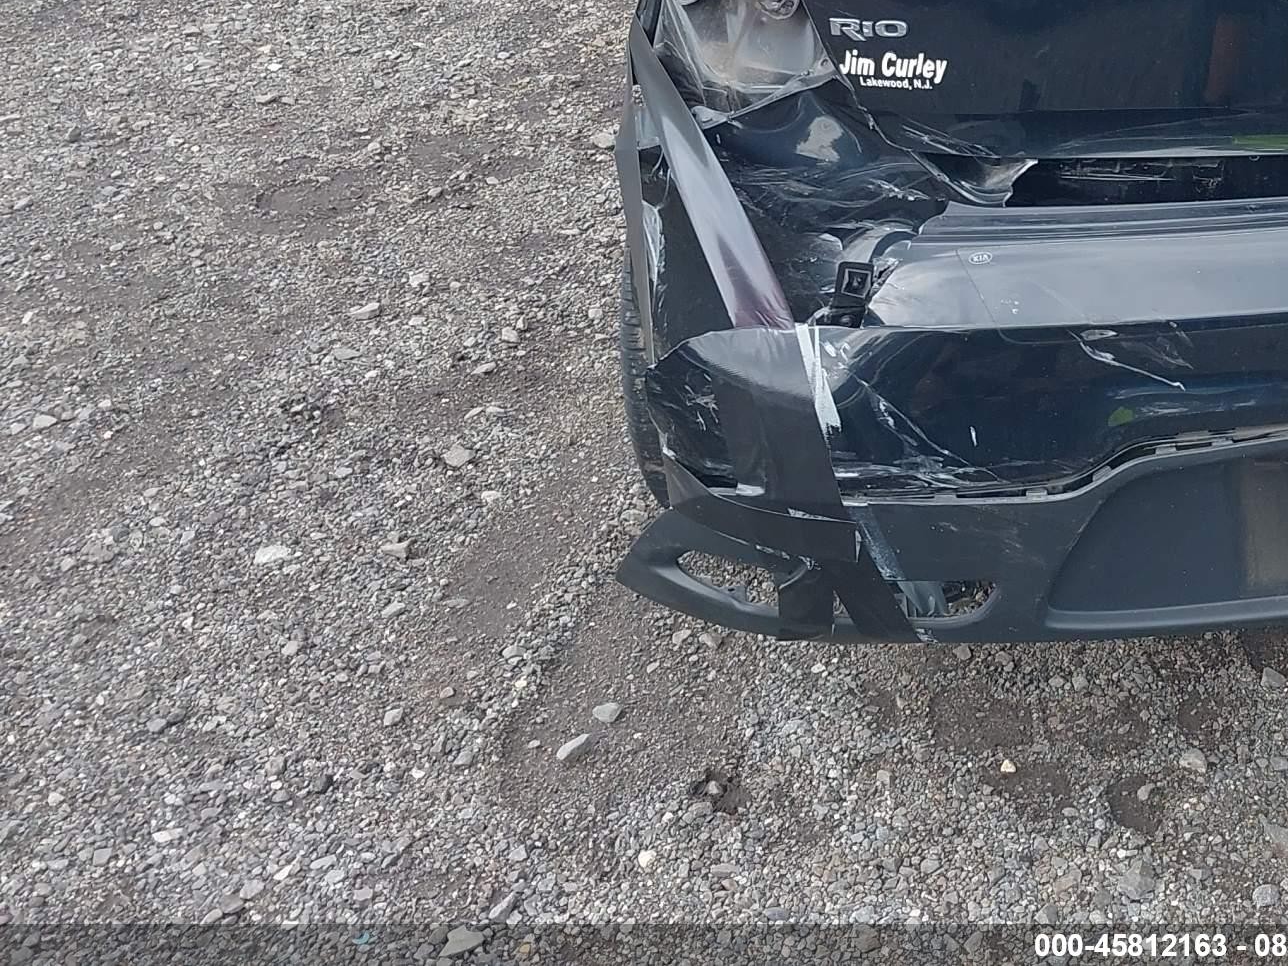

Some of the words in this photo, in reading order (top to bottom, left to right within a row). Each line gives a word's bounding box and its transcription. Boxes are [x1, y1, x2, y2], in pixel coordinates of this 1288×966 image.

[829, 18, 908, 42] RIO
[839, 49, 875, 75] Jim
[881, 51, 948, 84] Curley
[860, 76, 913, 90] Lakewood,
[914, 78, 933, 90] N.J.
